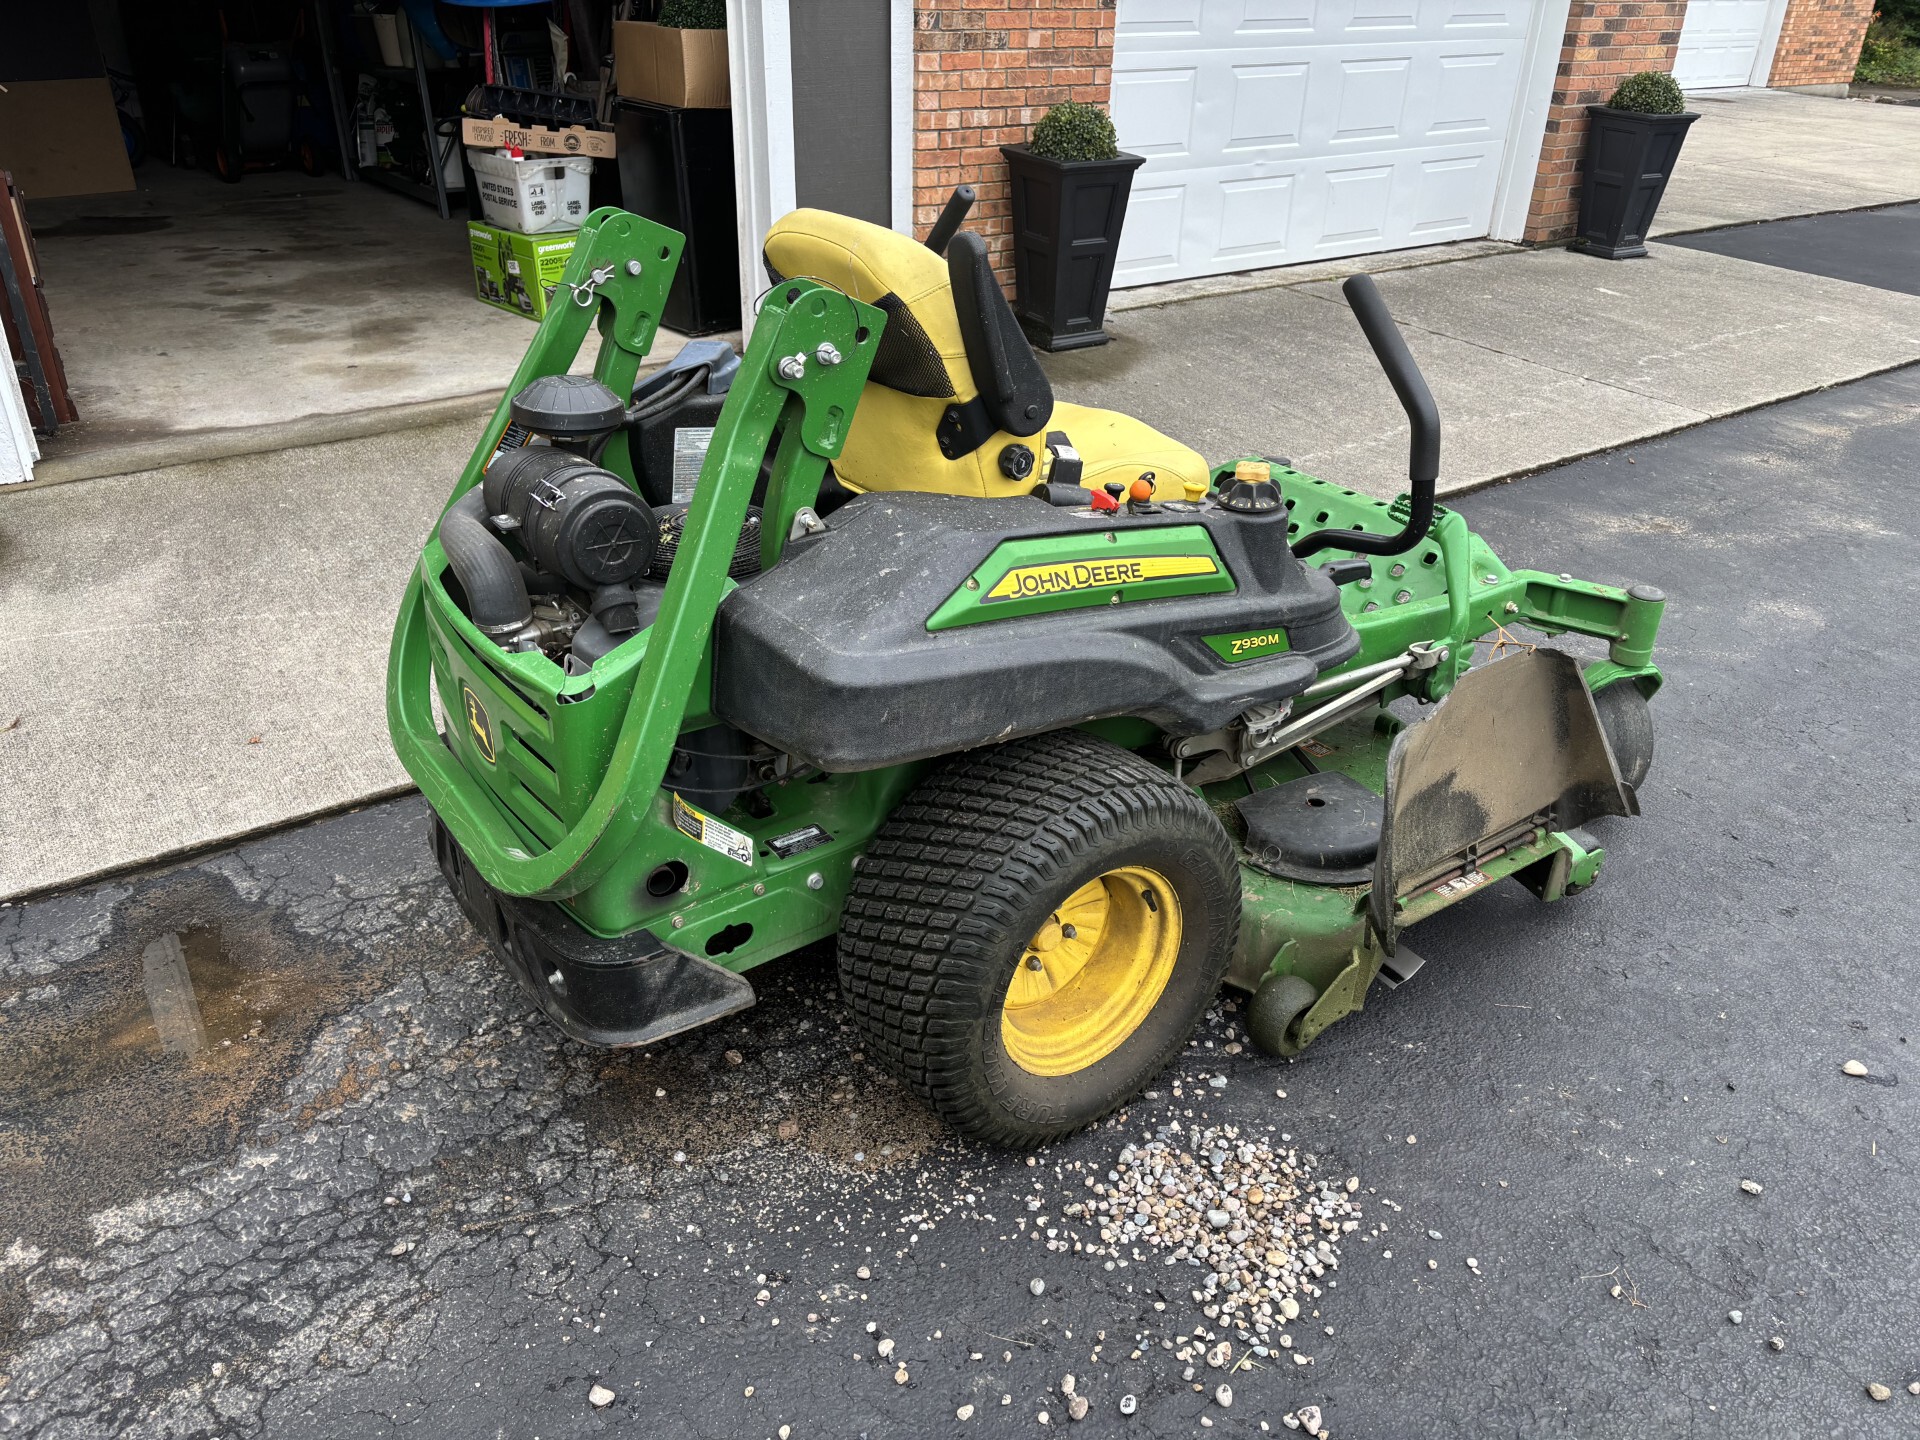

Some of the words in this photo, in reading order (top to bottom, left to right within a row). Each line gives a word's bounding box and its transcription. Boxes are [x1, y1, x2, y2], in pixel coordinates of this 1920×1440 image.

[472, 126, 494, 135] INSPIRED
[504, 130, 528, 147] FRESH
[540, 136, 556, 148] FROM
[482, 181, 496, 192] UNITED
[497, 185, 514, 197] STATES
[482, 191, 498, 204] POSTAL
[498, 196, 518, 209] SERVICE
[541, 257, 558, 266] 2200
[1011, 570, 1072, 595] JOHN
[1073, 562, 1144, 585] DEERE
[1231, 633, 1279, 655] Z930M
[999, 1093, 1068, 1124] TURF
